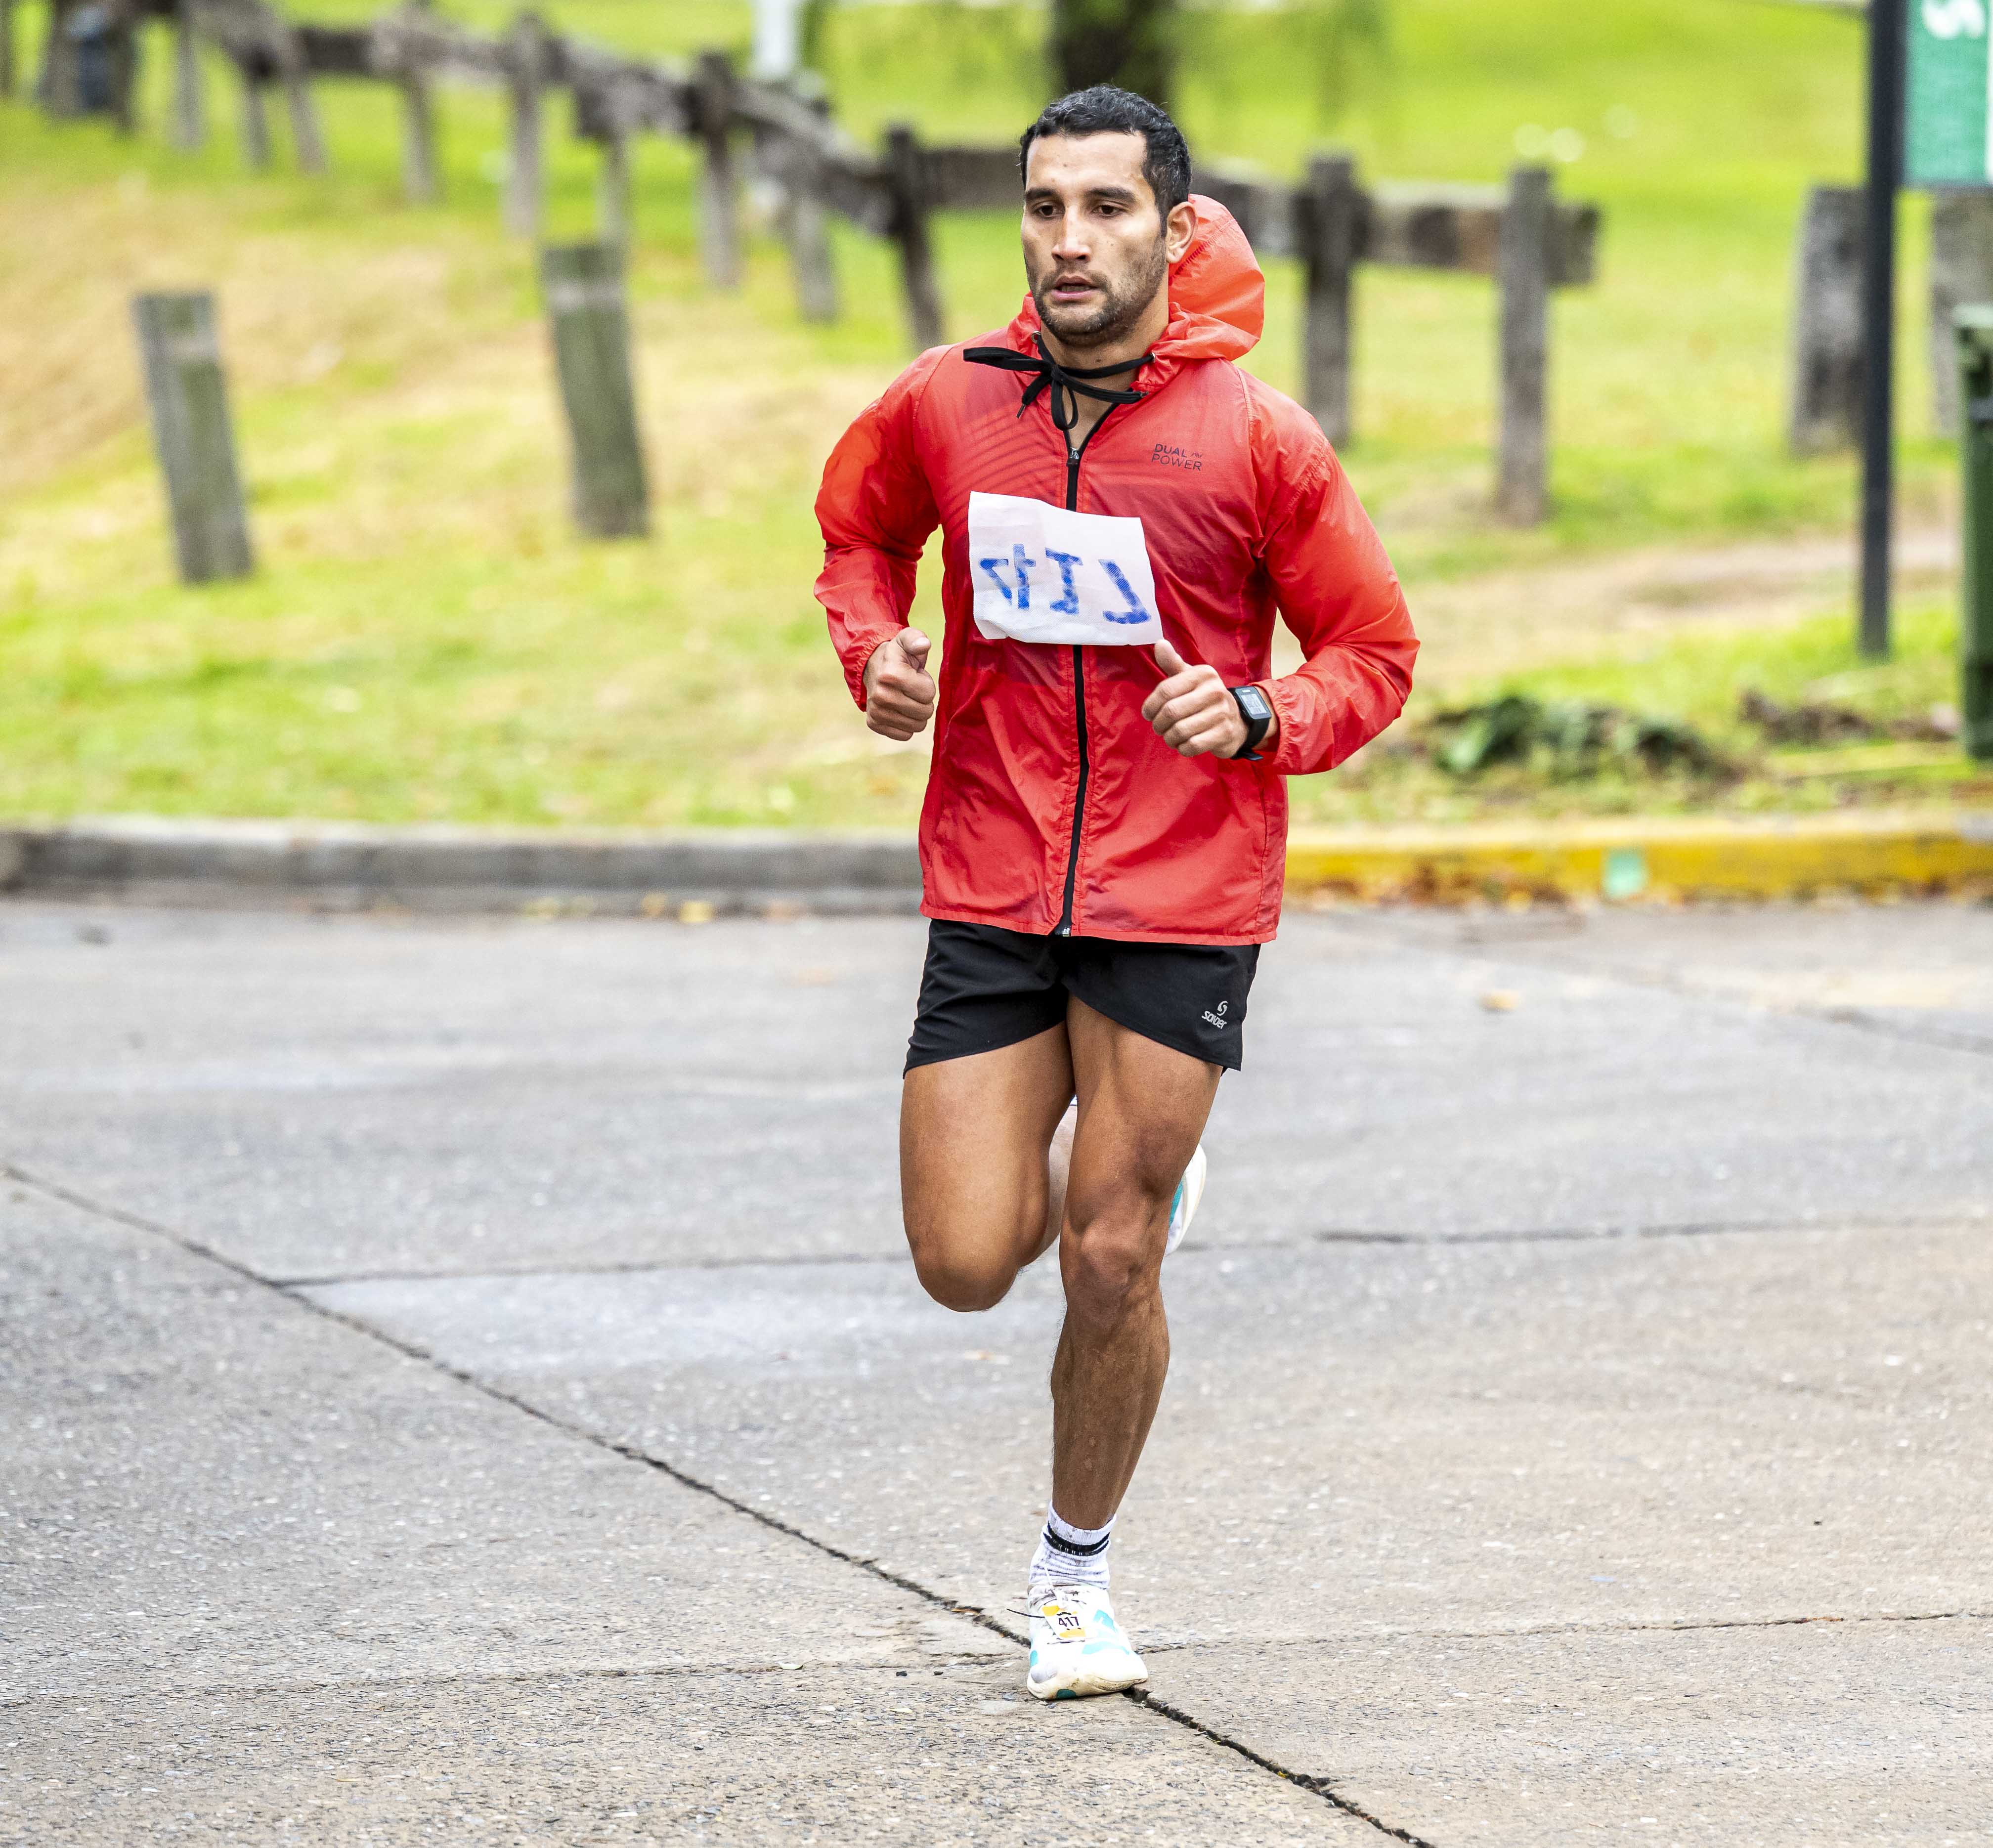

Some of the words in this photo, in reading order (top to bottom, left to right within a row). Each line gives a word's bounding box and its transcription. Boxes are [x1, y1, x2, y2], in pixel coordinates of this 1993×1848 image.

[1154, 443, 1187, 457] DUAL
[1151, 453, 1202, 471] POWER
[1058, 1616, 1080, 1627] 417
